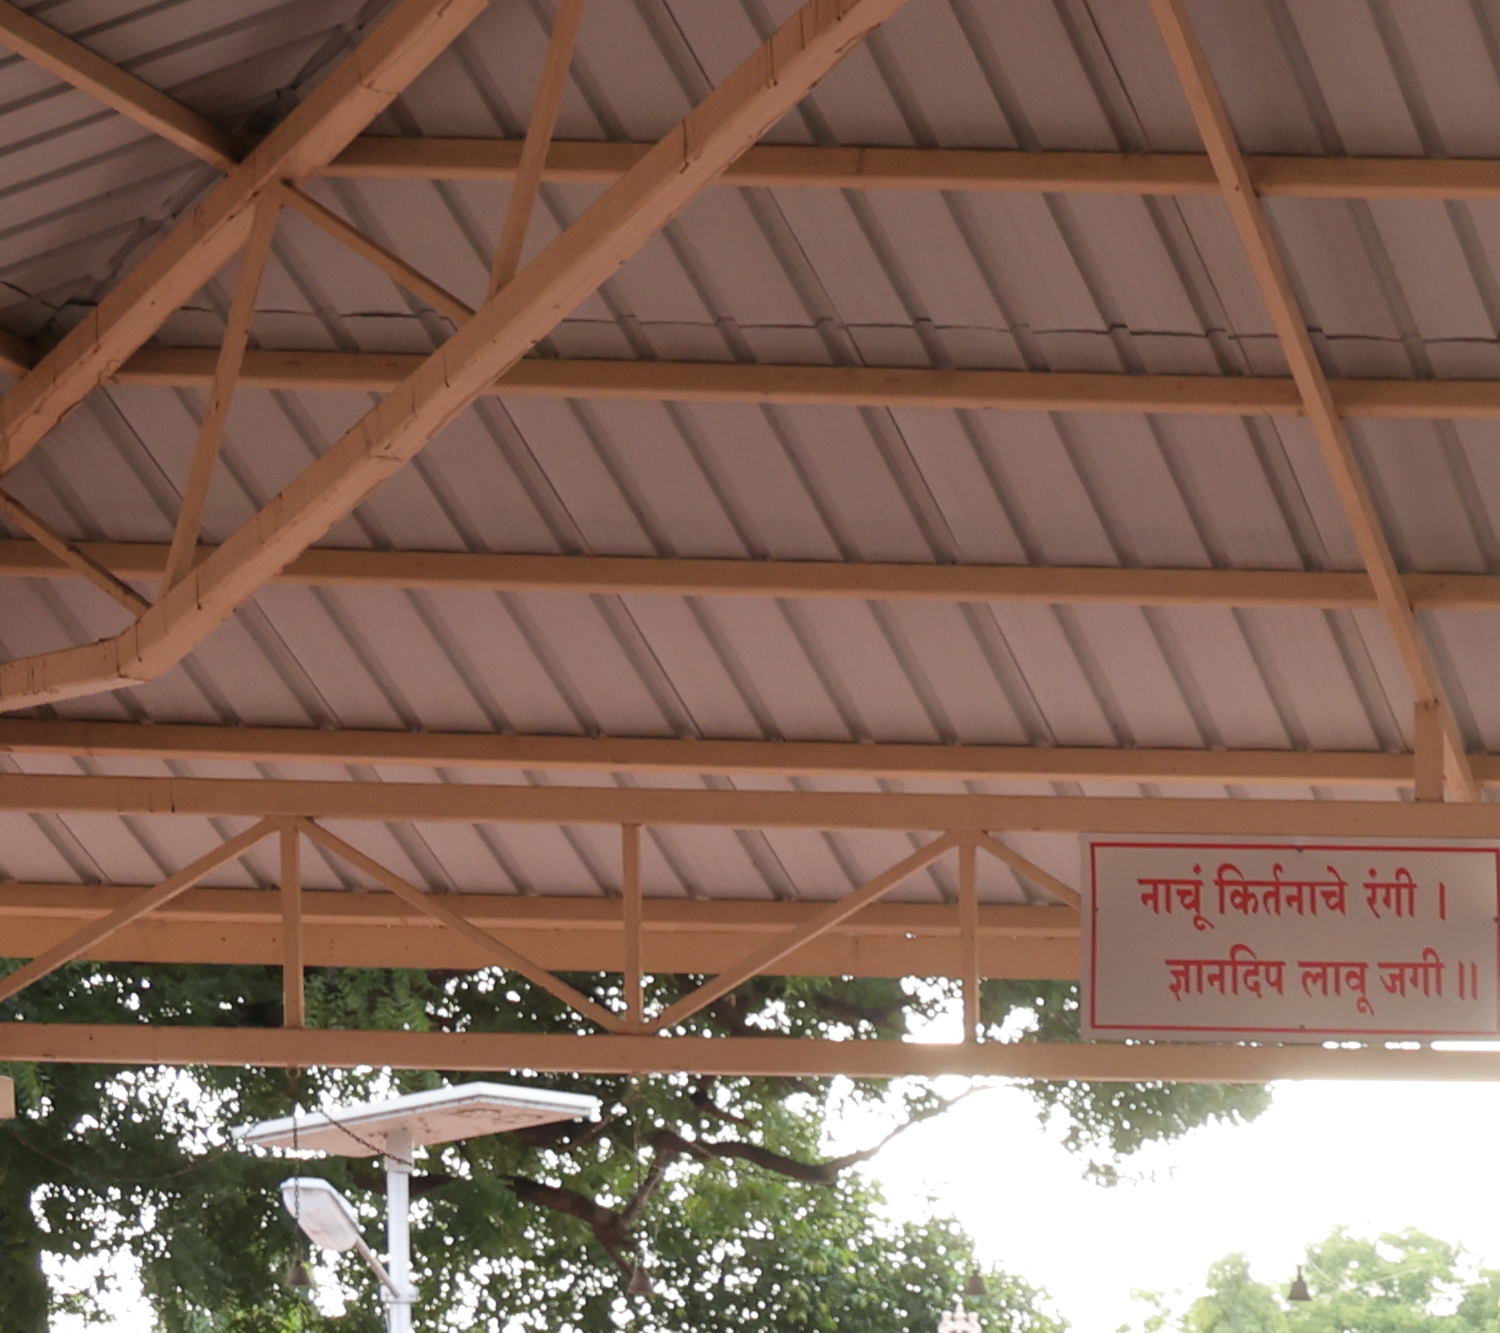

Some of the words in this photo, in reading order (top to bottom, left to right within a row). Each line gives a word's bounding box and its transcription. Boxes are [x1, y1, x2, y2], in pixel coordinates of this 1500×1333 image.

[1137, 864, 1214, 931] नाचूं
[1214, 863, 1348, 914] किर्तनाचे
[1363, 867, 1418, 917] रंगी
[1166, 943, 1286, 999] ज्ञानदिप
[1297, 960, 1374, 1015] लावू
[1378, 947, 1446, 998] जगी
